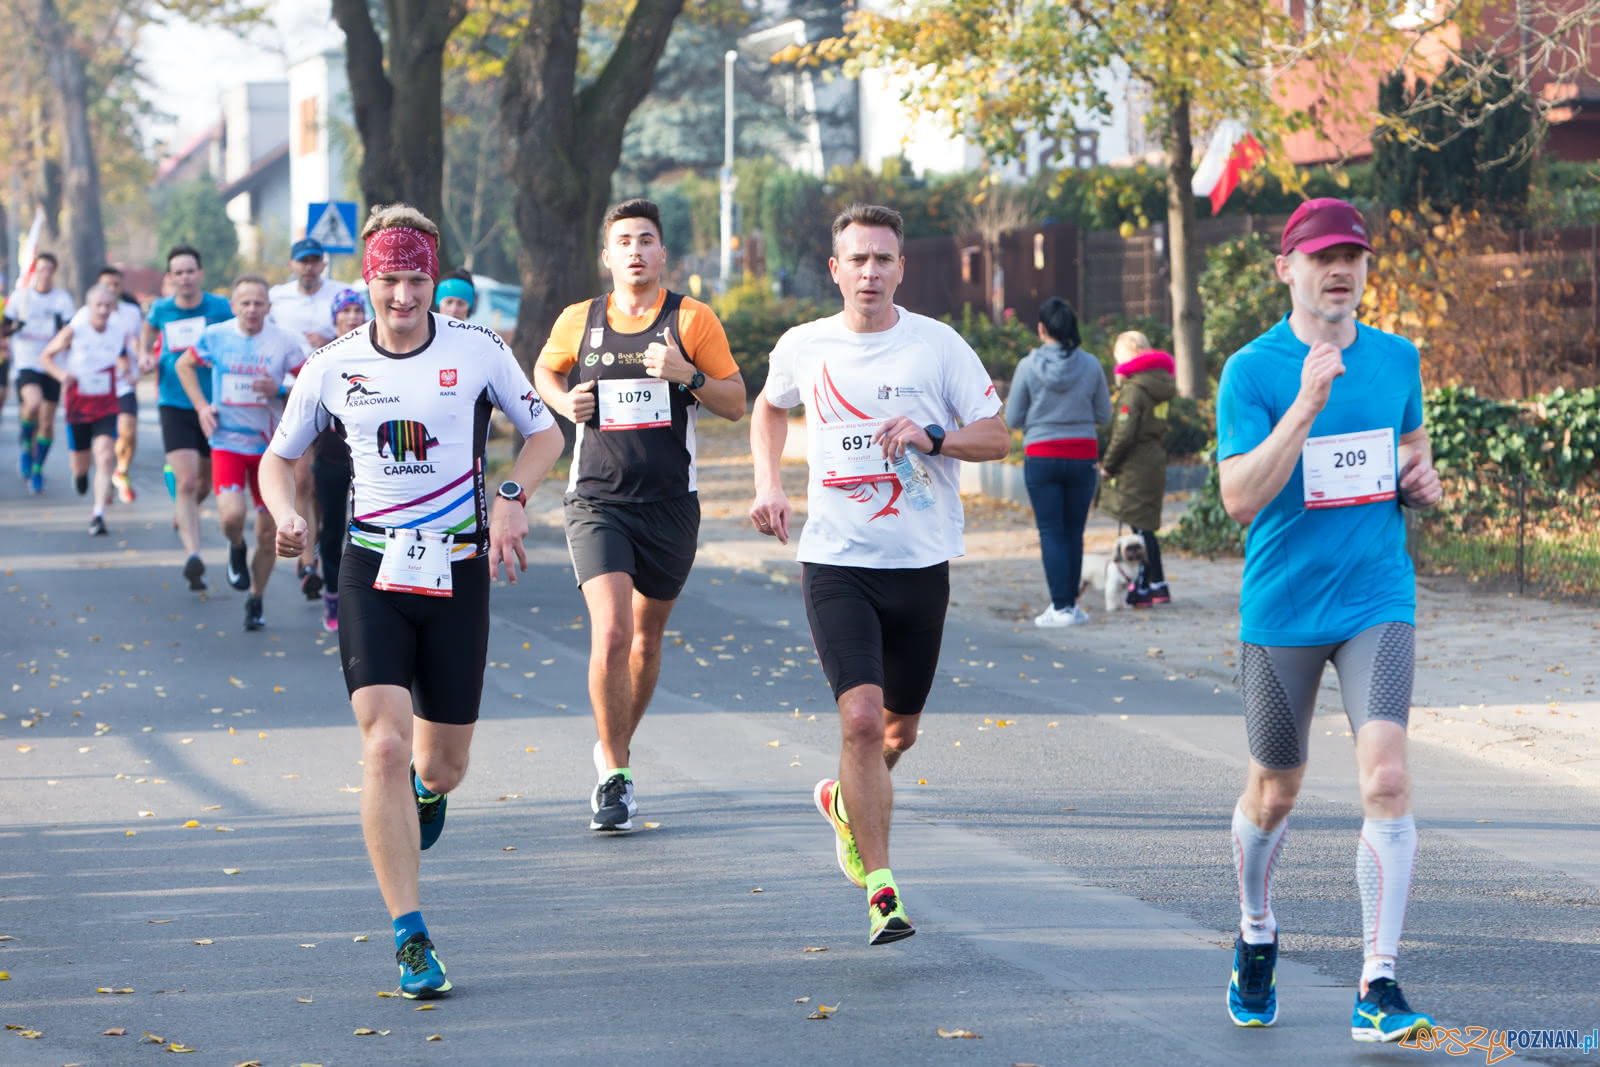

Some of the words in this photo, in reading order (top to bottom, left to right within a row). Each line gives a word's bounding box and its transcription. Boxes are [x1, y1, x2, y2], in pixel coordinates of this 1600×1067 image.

[447, 320, 505, 351] CAPAROL
[349, 395, 401, 407] KRAKOWIAK
[617, 390, 652, 403] 1079
[842, 434, 873, 451] 697
[1333, 449, 1367, 468] 209
[383, 464, 436, 476] CAPAROL
[407, 544, 426, 561] 47
